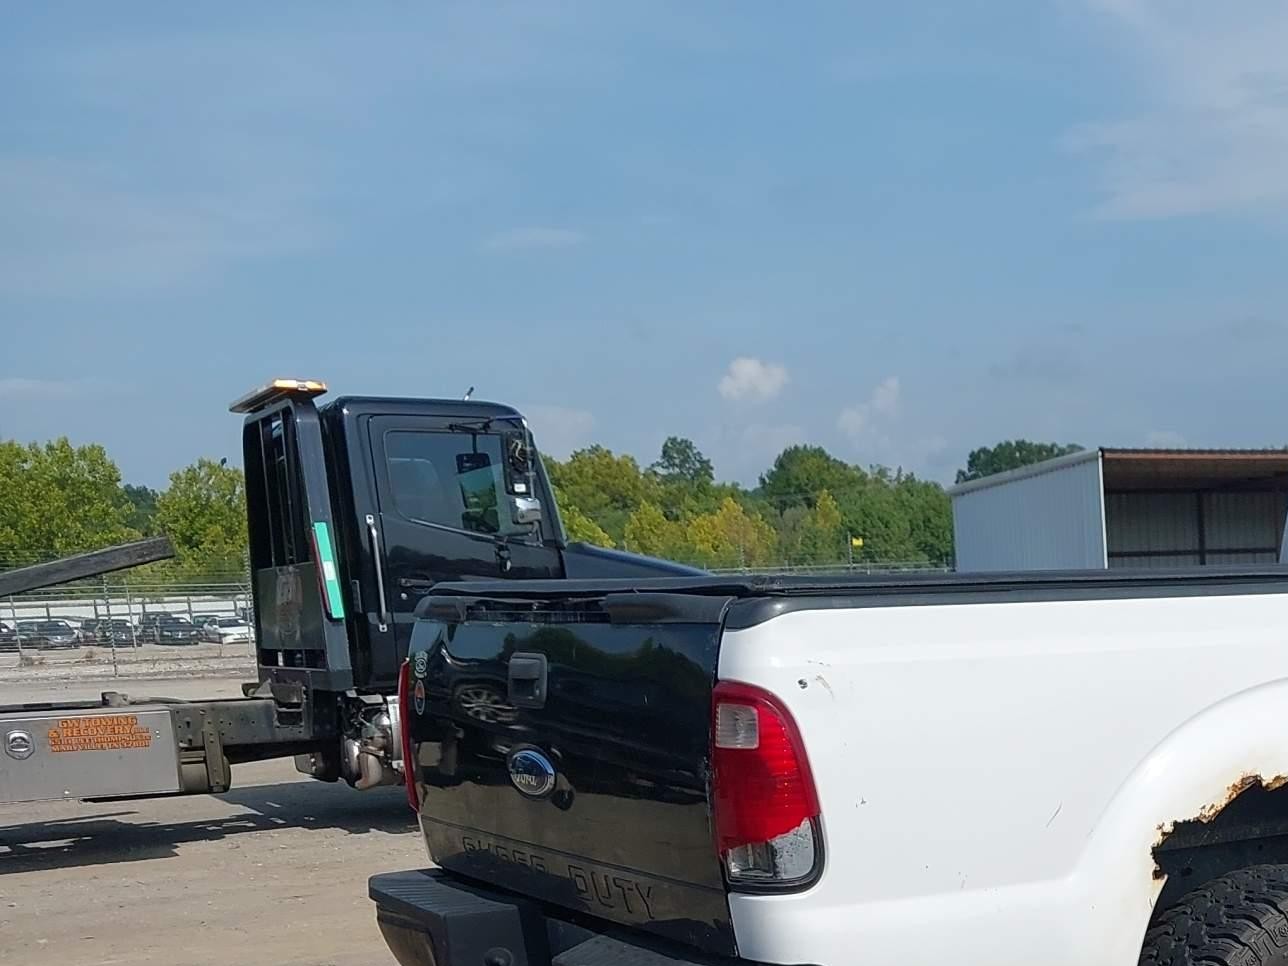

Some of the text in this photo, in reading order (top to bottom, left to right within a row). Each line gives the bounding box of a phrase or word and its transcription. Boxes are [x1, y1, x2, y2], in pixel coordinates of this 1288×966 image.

[58, 715, 138, 728] GW TOWING
[48, 729, 59, 739] &
[63, 724, 132, 738] RECOVERY
[566, 863, 657, 921] DUTY
